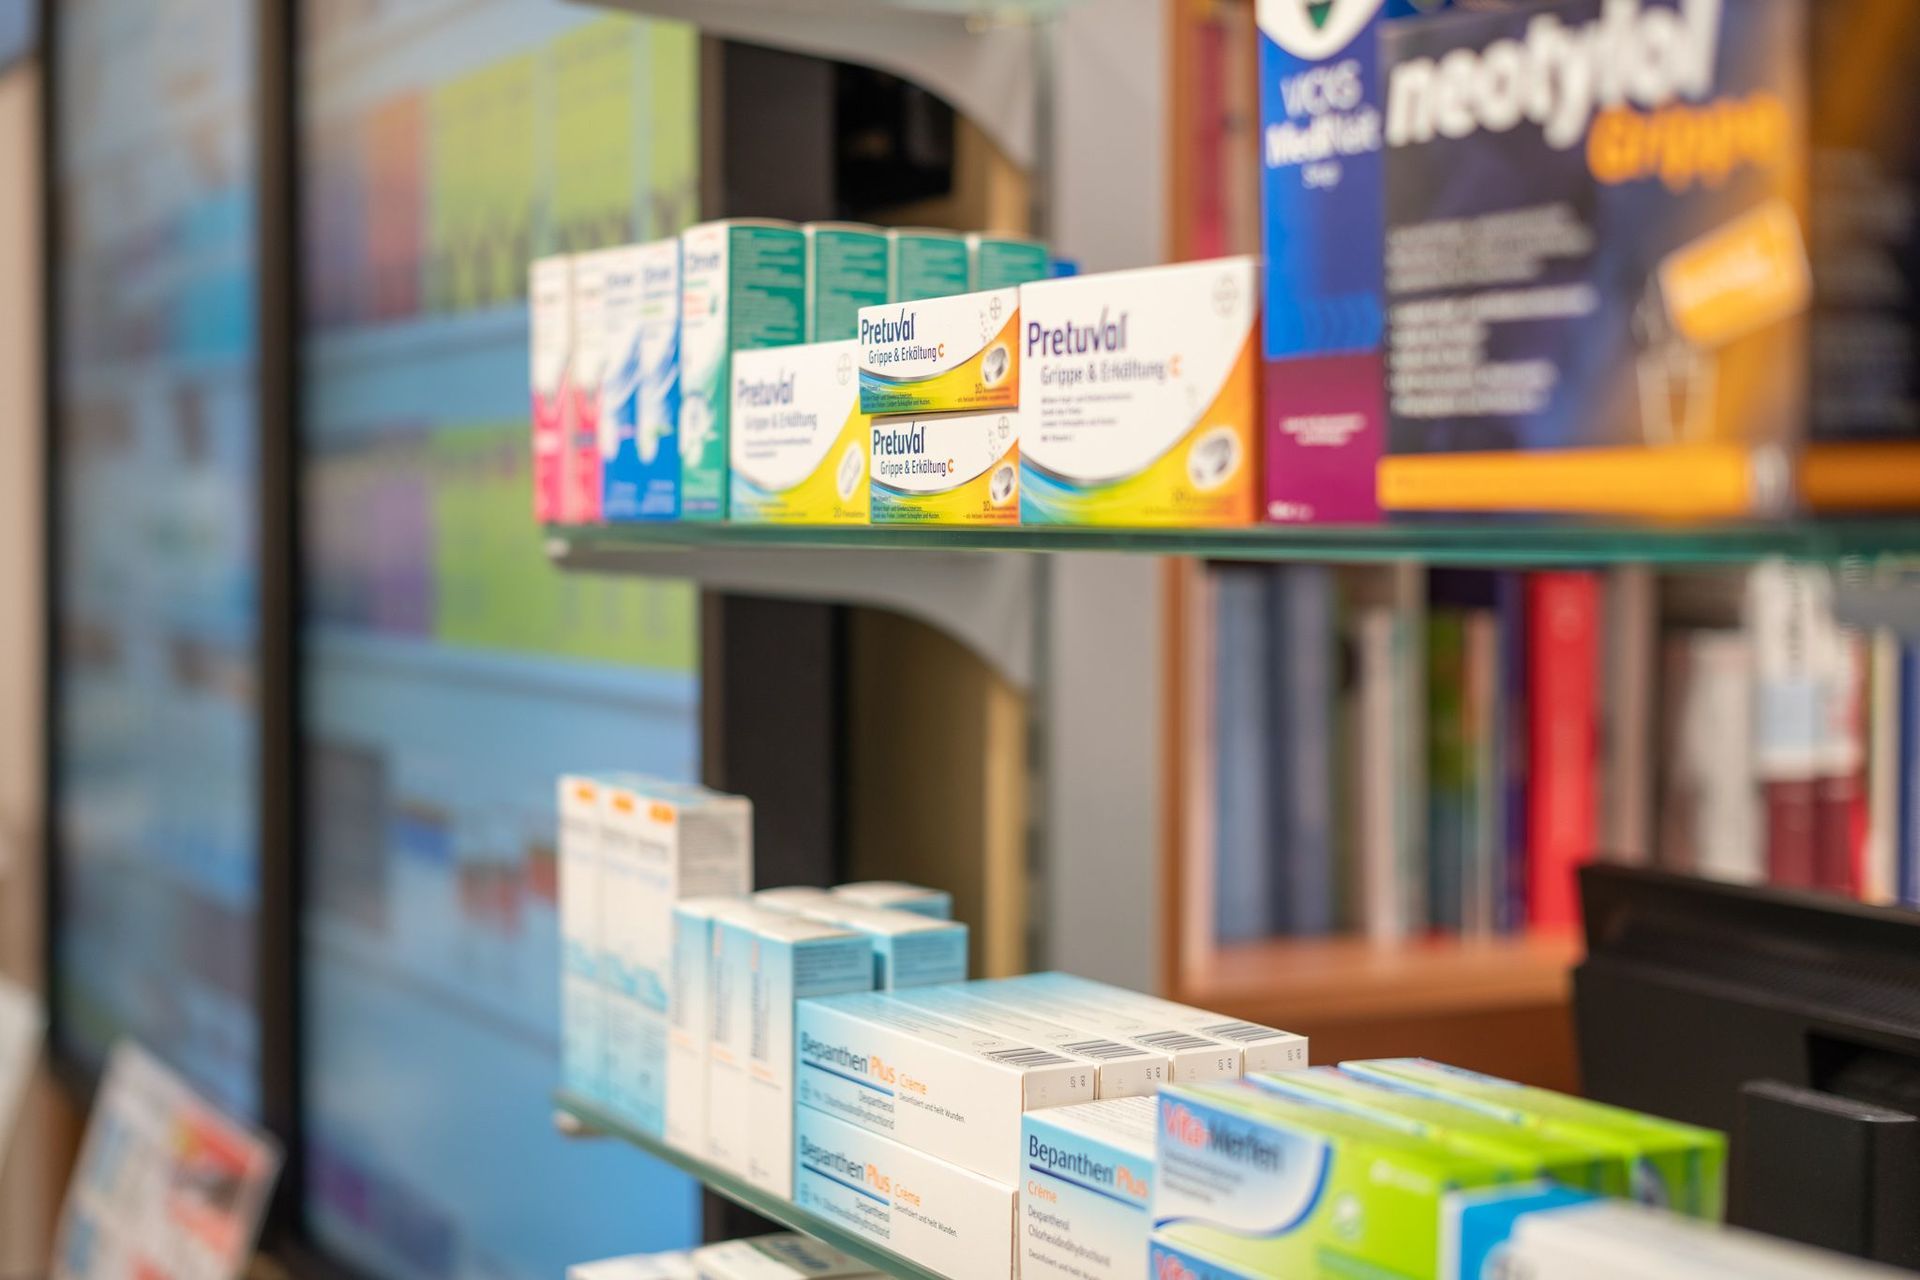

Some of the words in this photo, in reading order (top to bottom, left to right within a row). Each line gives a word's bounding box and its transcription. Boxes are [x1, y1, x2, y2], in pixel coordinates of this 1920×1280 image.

[861, 308, 915, 345] Pretuval
[1027, 305, 1129, 358] Pretuval
[869, 348, 892, 368] Grippe
[894, 348, 900, 361] &
[901, 344, 937, 363] Erkältung
[938, 343, 945, 358] C
[1041, 366, 1082, 387] Grippe
[1086, 363, 1097, 382] &
[1101, 359, 1166, 385] Erkältung
[1169, 354, 1183, 378] C
[738, 367, 795, 406] Pretuval
[873, 421, 925, 455] Pretuval
[880, 461, 903, 478] Grippe
[904, 460, 910, 474] &
[911, 459, 946, 477] Erkältung
[947, 459, 954, 474] C
[801, 1031, 868, 1074] Bepanthen
[870, 1056, 896, 1084] Plus
[925, 1102, 933, 1112] und
[801, 1135, 864, 1181] Bepanthen
[866, 1163, 890, 1193] Plus
[1029, 1134, 1113, 1184] Bepanthen
[1116, 1164, 1148, 1199] Plus
[1028, 1180, 1057, 1203] Crème
[918, 1213, 926, 1222] und
